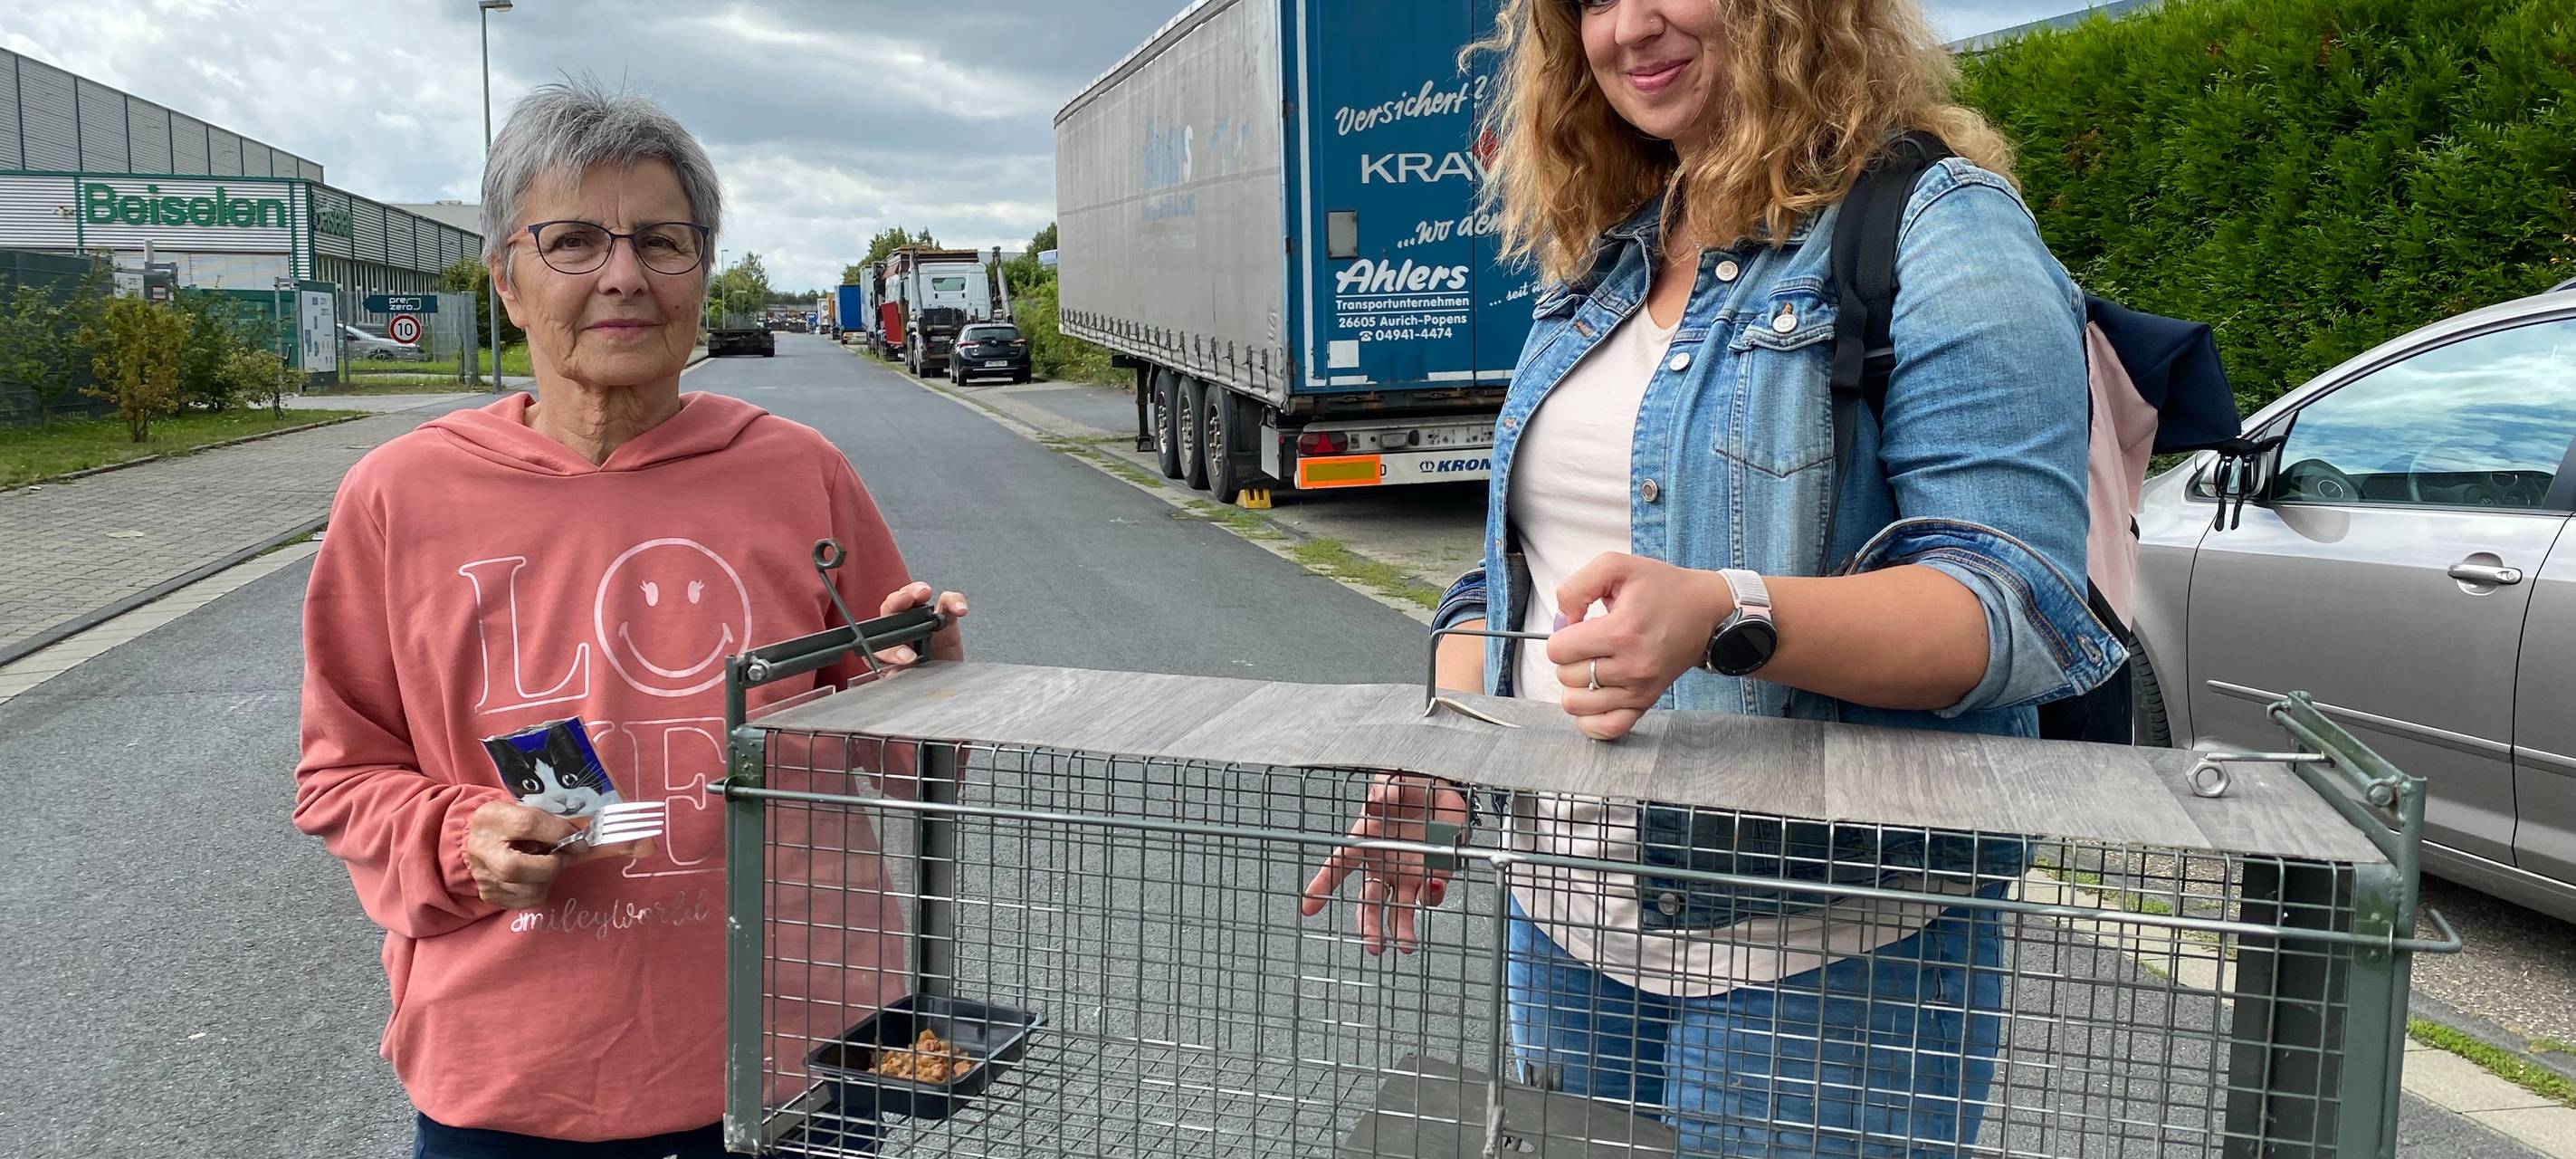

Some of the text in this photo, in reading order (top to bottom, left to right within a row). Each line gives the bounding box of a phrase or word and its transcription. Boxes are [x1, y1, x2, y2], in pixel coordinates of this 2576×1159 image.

[1361, 151, 1491, 184] KRAV
[84, 183, 286, 226] Beiselen
[1335, 259, 1470, 293] Ahlers
[389, 297, 406, 306] pre
[1336, 297, 1470, 311] Transportunternehmen
[1339, 314, 1468, 329] 26605 Aurich-Popens
[397, 323, 413, 336] 10
[1375, 328, 1453, 340] 04941-4474
[1436, 458, 1492, 472] KRON
